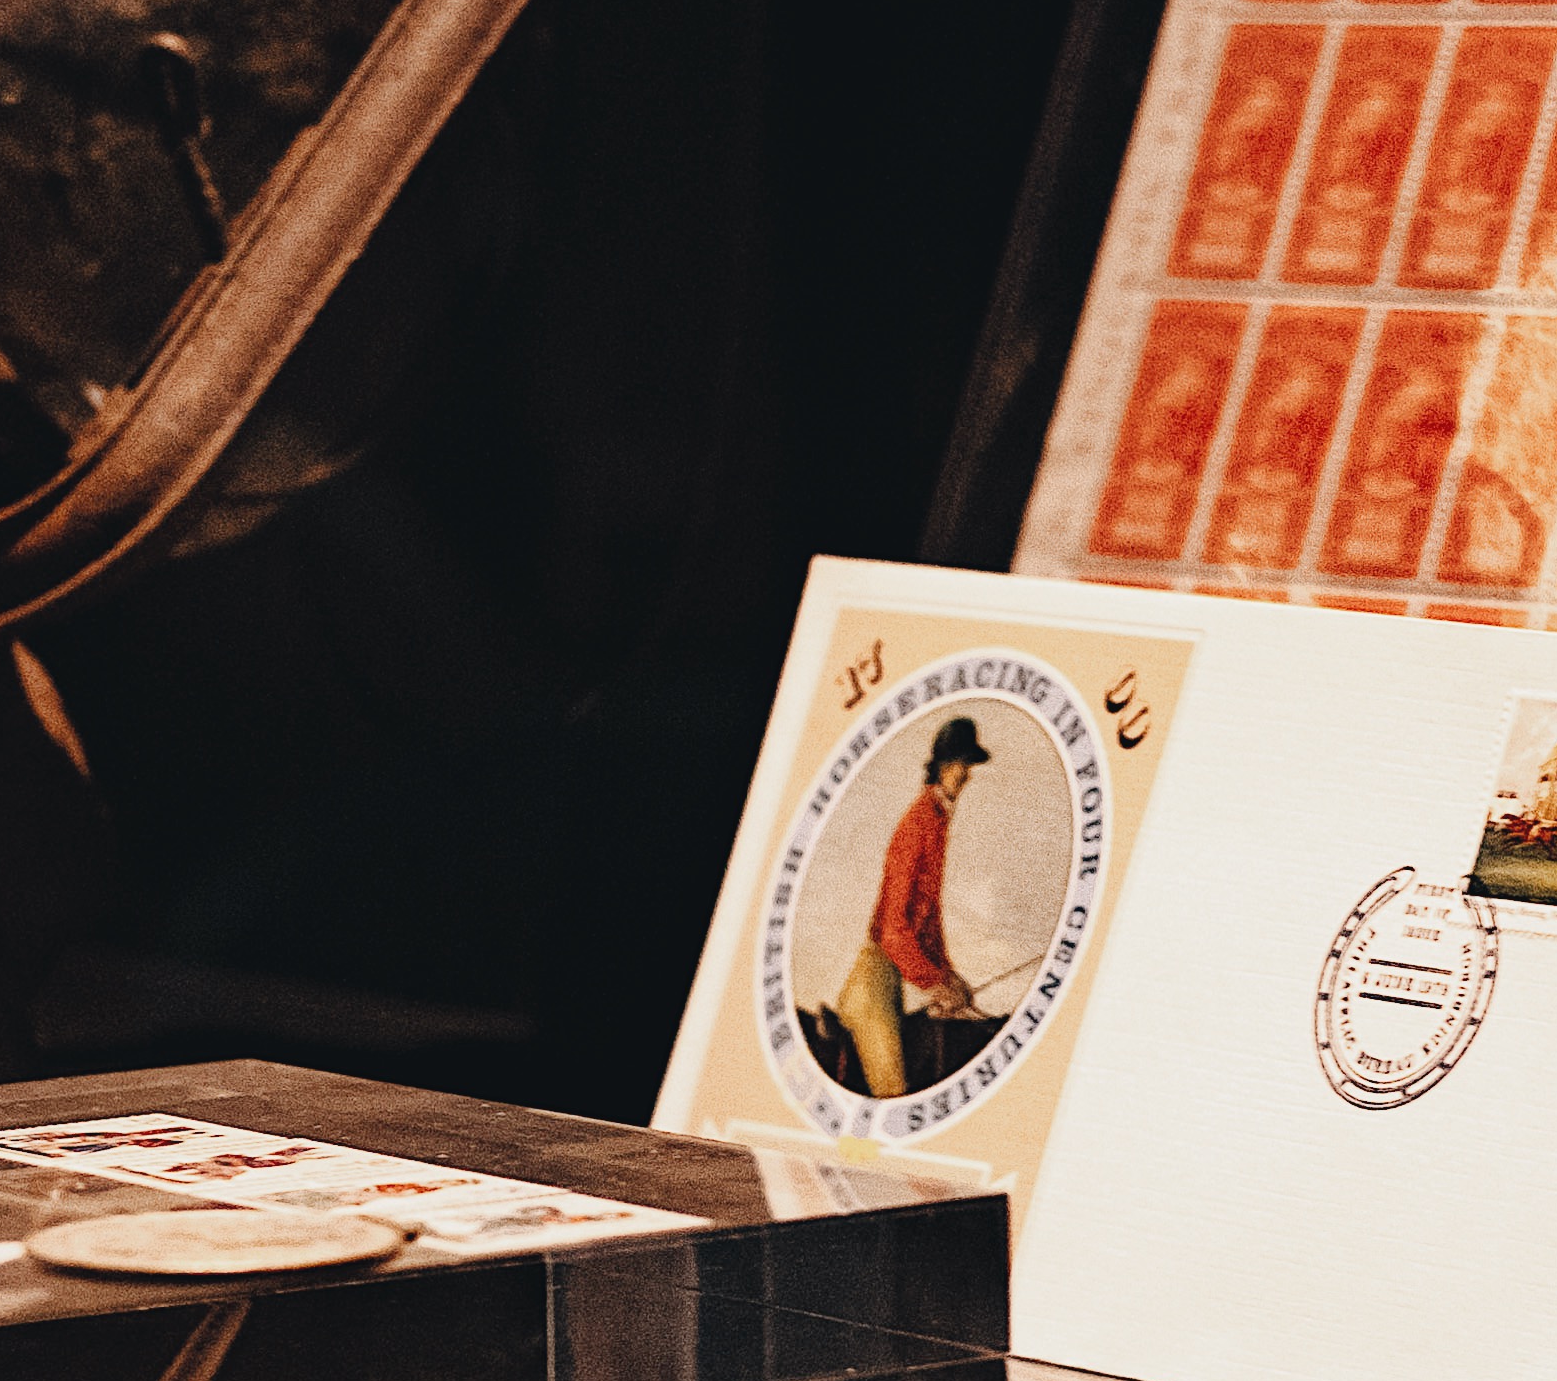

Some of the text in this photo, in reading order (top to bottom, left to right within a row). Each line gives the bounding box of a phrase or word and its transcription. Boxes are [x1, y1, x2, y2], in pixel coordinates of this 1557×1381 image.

[761, 656, 1104, 1133] BRITISH HORSERACING IN FOUR CENTURIES
